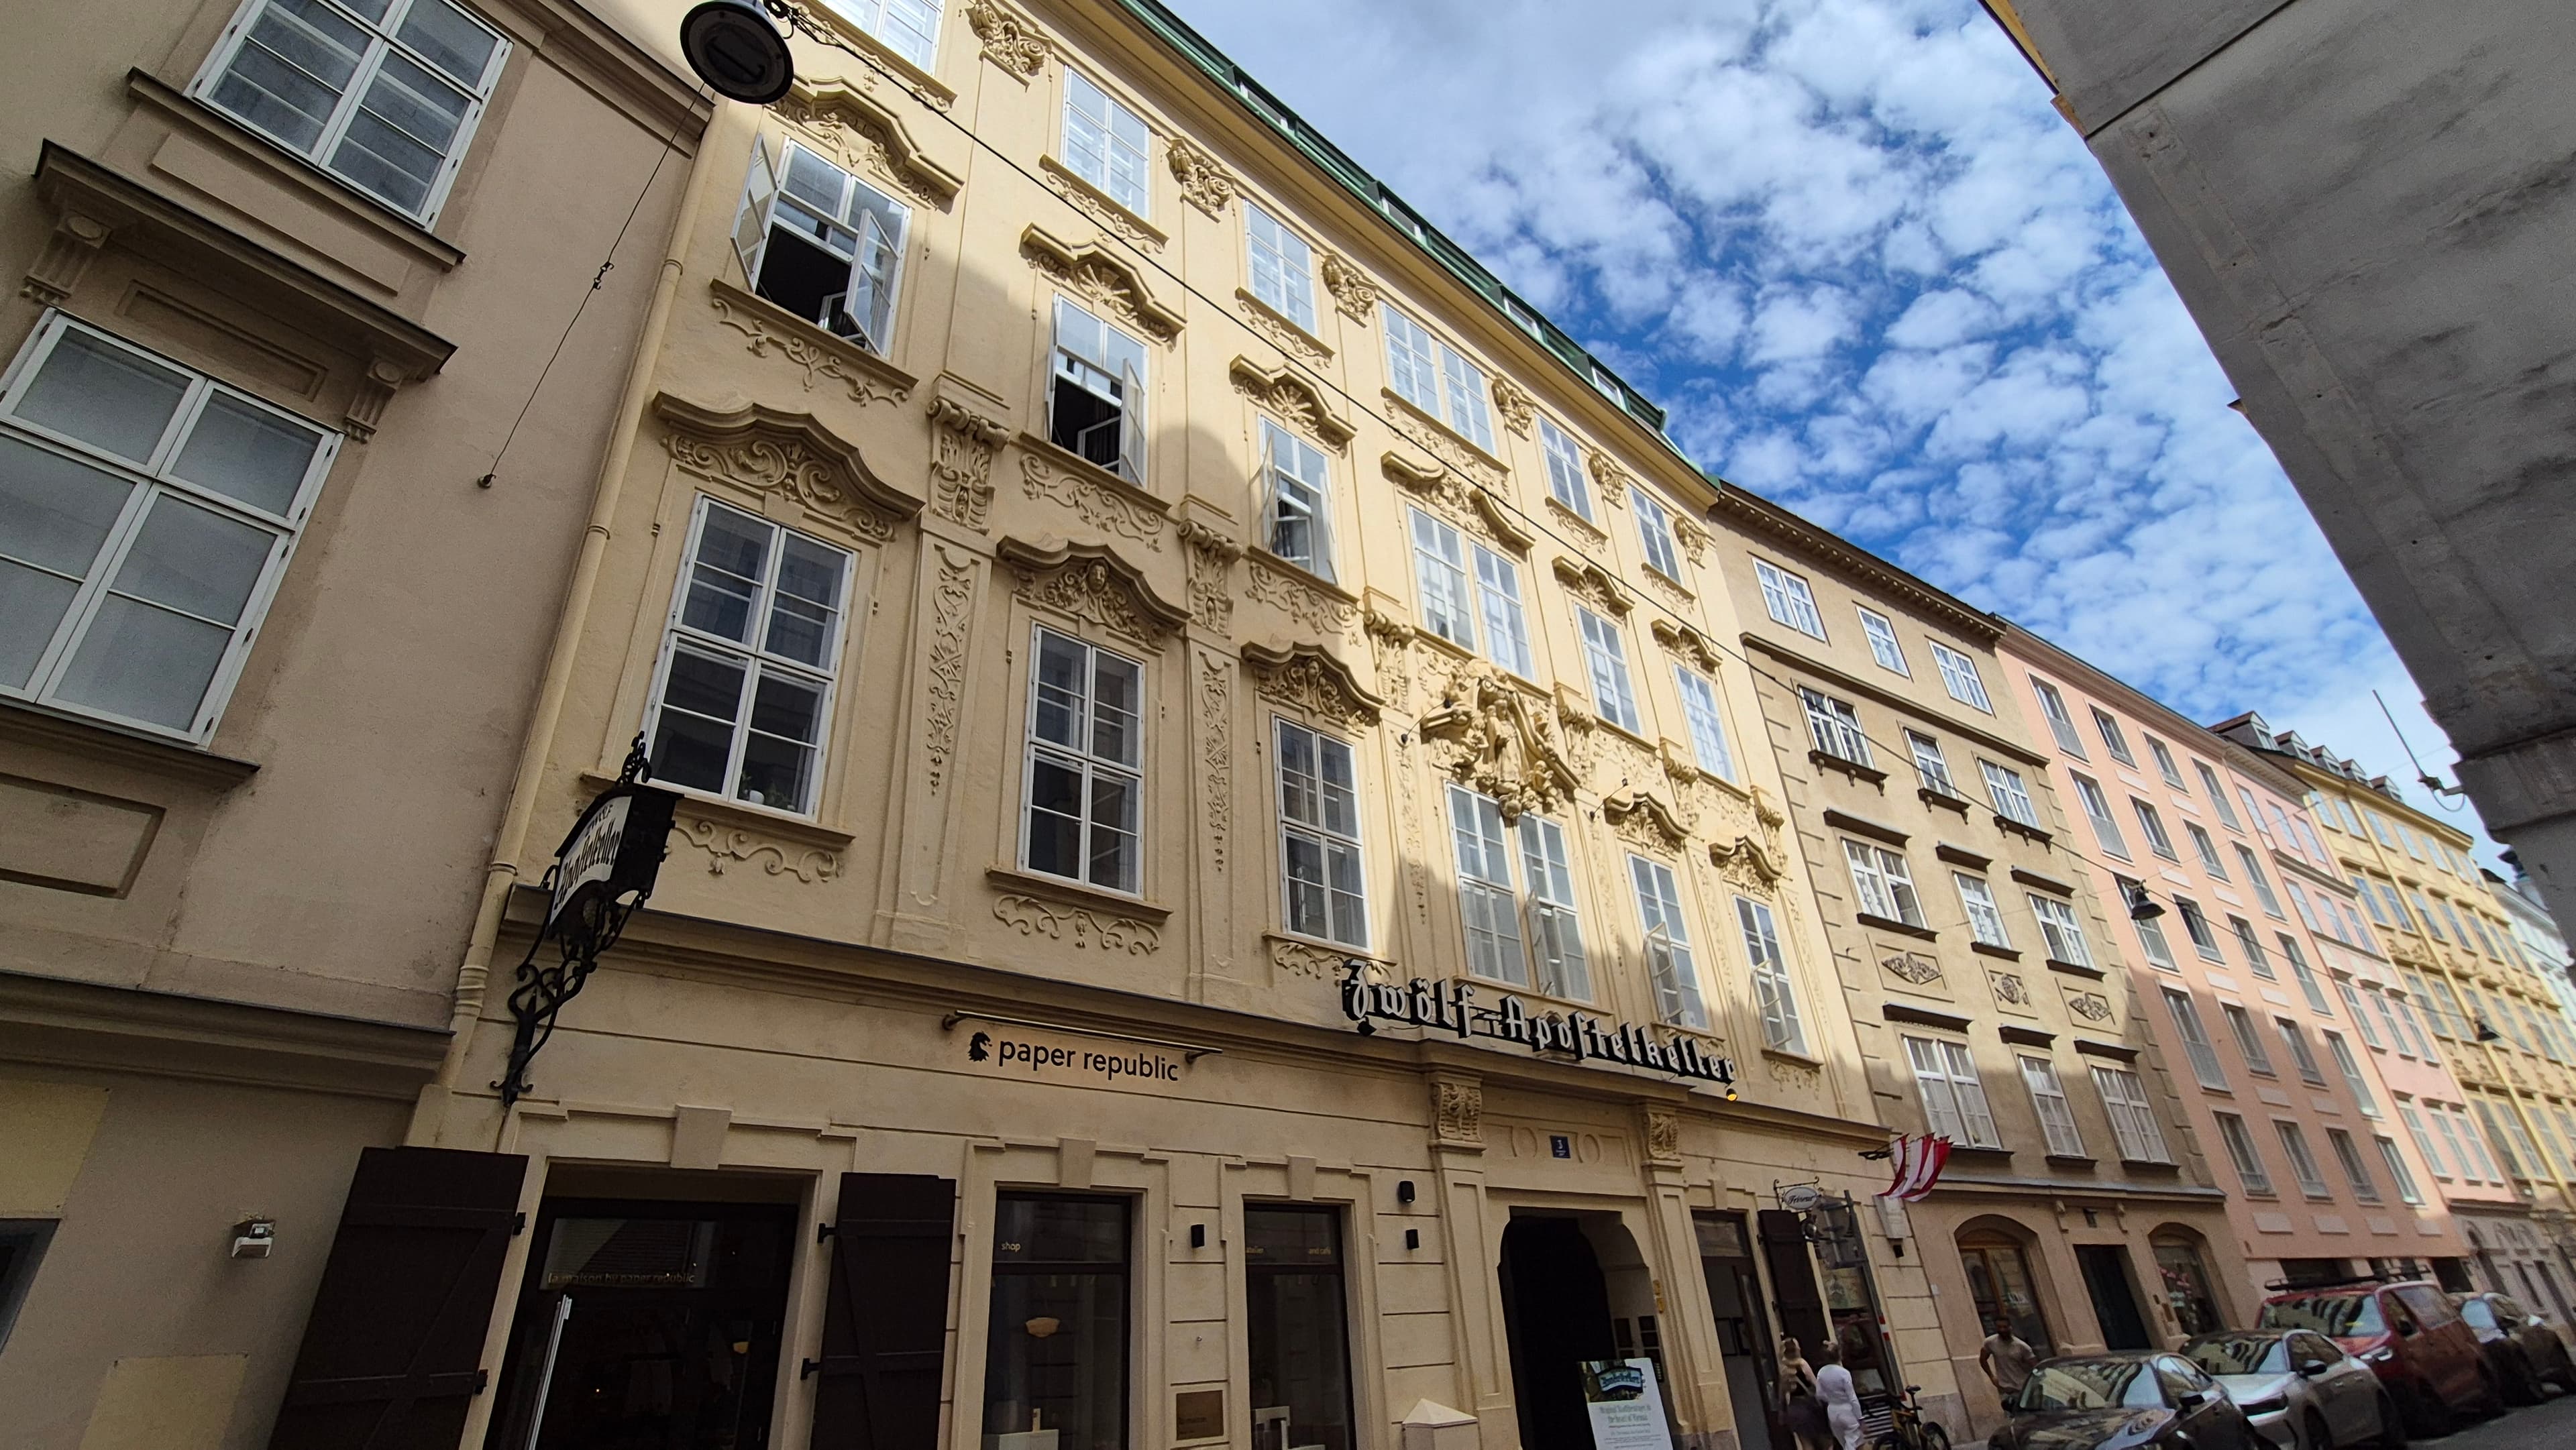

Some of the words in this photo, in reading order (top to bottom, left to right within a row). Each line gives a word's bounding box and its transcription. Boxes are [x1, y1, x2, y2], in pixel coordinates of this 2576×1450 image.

[998, 1040, 1076, 1071] paper
[1083, 1052, 1179, 1081] republic
[1001, 1241, 1021, 1253] shop
[653, 1272, 695, 1285] republic
